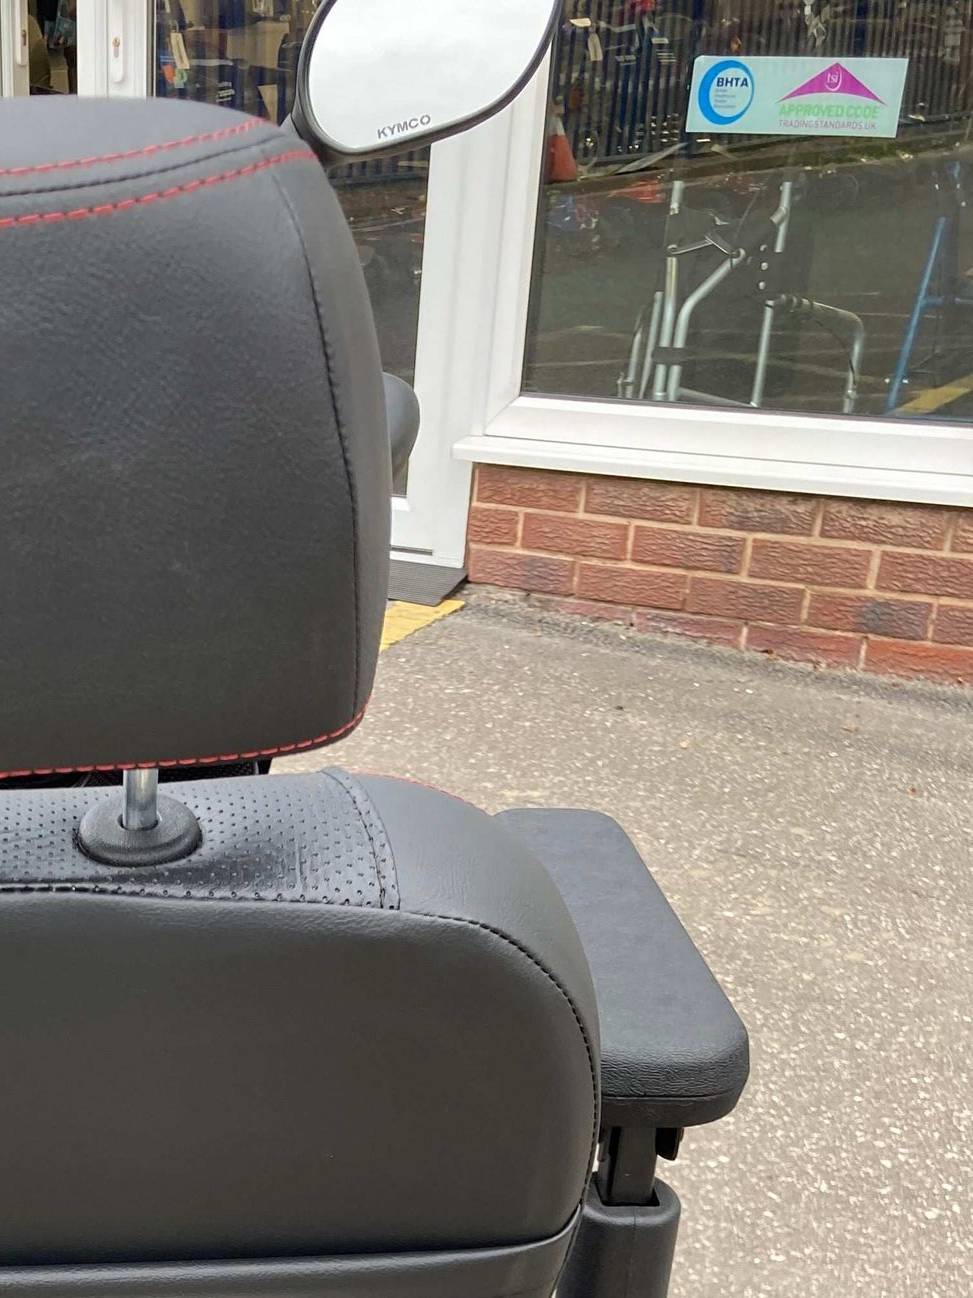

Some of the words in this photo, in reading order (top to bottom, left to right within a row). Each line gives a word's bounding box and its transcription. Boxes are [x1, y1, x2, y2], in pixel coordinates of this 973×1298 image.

[717, 77, 749, 88] BHTA
[779, 103, 844, 118] APPROVED
[846, 105, 879, 119] CODE
[377, 114, 431, 139] KYMCO
[779, 119, 876, 130] TRADINGSTANDARDS.UK
